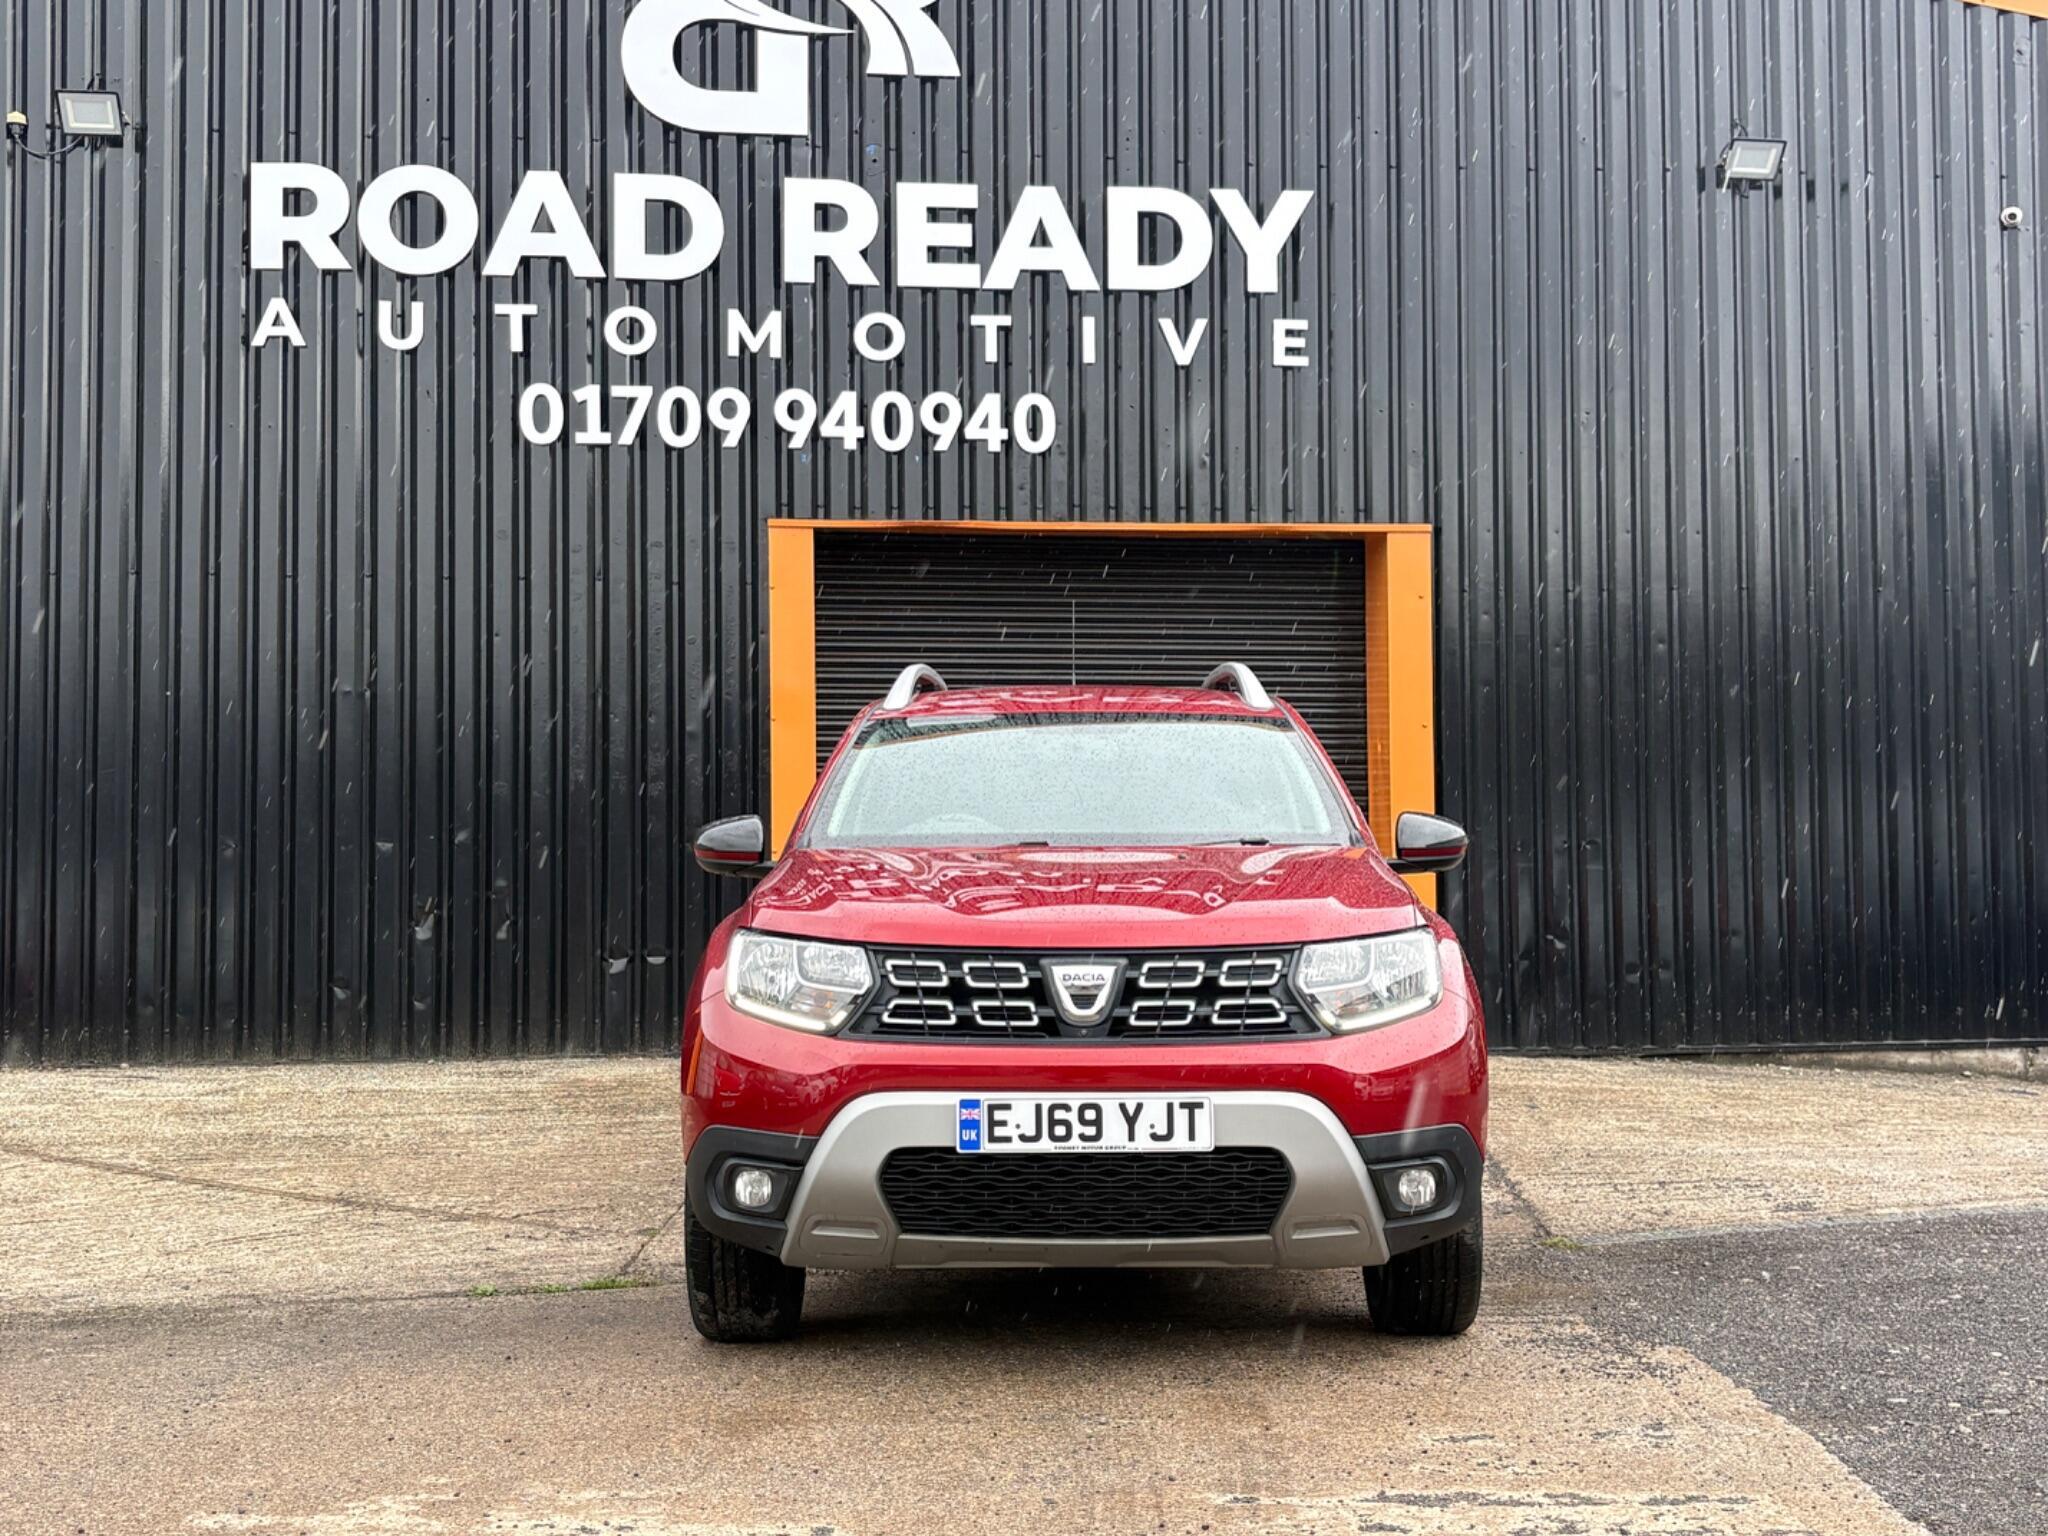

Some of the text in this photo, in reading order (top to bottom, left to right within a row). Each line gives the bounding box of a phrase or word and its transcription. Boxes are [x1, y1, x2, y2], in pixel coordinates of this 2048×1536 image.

[249, 162, 1315, 294] ROAD READY
[249, 297, 1310, 368] AUTOMOTIVE
[518, 382, 1057, 454] 01709 940940
[1062, 973, 1105, 982] DACIA
[962, 1129, 977, 1141] UK
[987, 1102, 1204, 1143] EJ69 YJT
